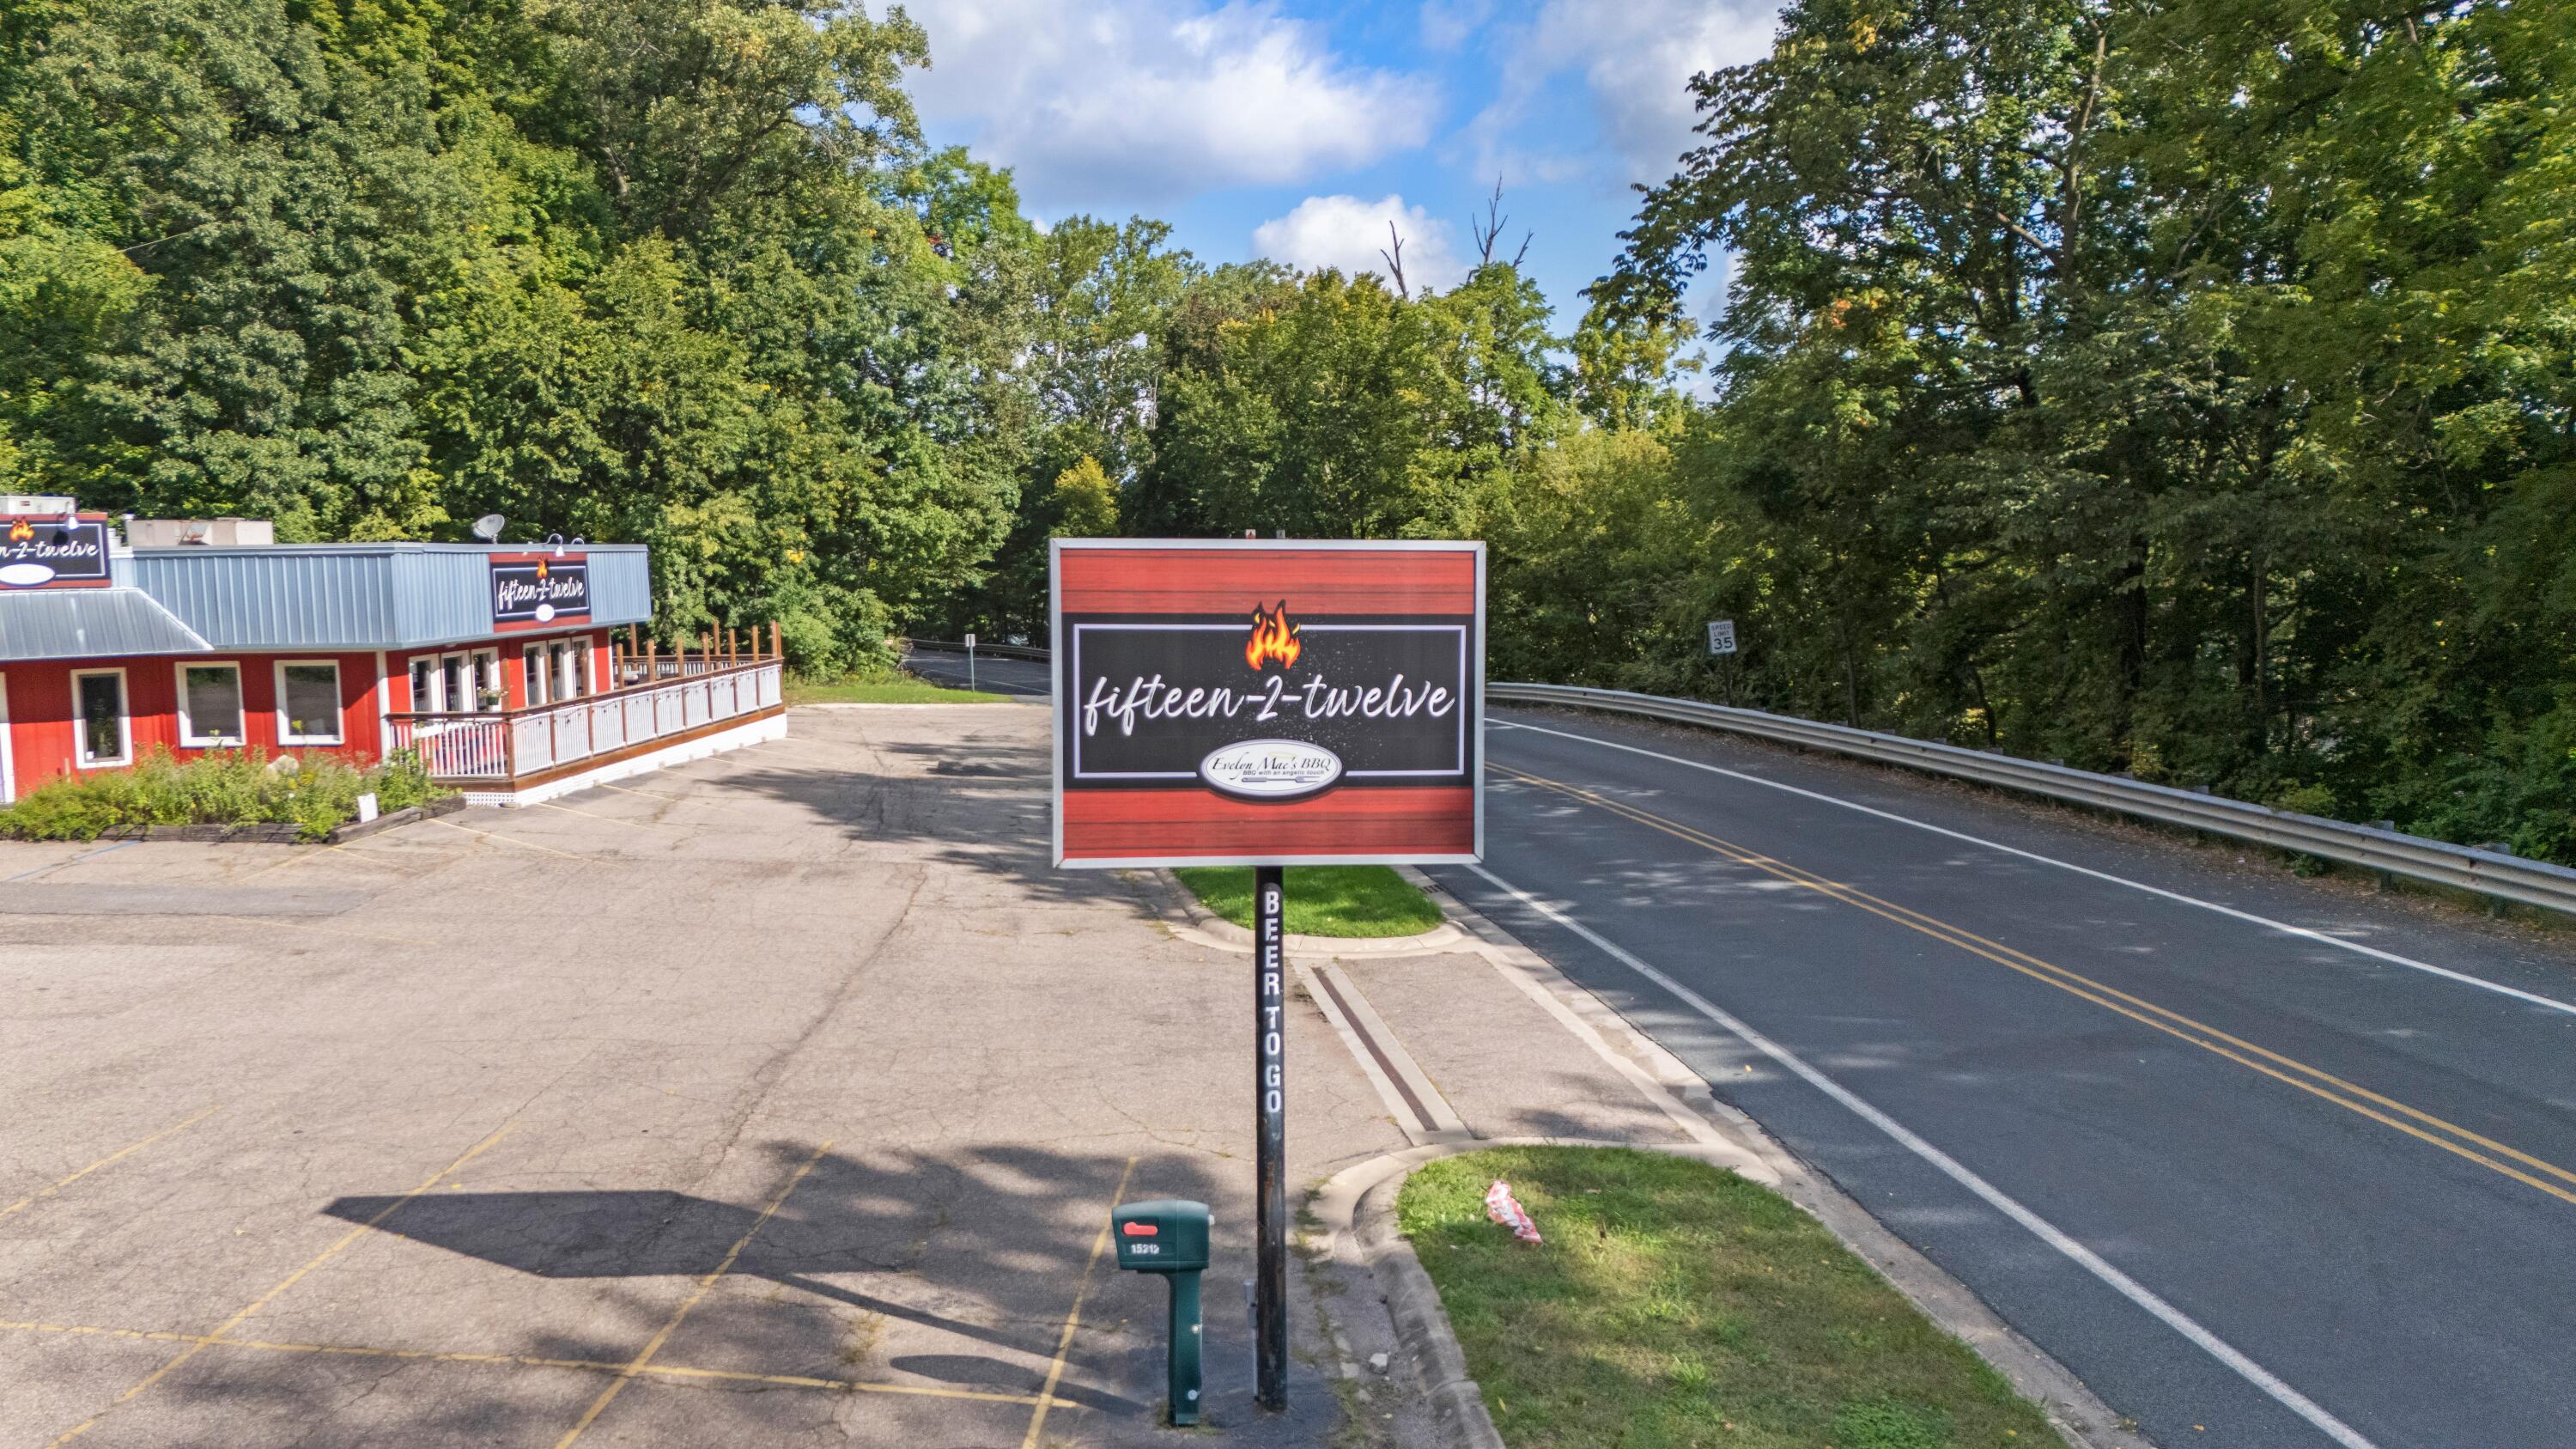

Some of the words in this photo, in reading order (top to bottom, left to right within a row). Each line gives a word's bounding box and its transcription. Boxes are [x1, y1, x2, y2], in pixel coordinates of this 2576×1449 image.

[497, 576, 585, 611] fifteen-2-twelve
[1714, 636, 1733, 649] 35
[1083, 673, 1455, 736] fifteen-2-twelve
[1256, 756, 1297, 770] Mae's
[1301, 758, 1331, 771] BBQ
[1264, 891, 1279, 995] BEER
[1265, 1006, 1280, 1056] TO
[1265, 1064, 1281, 1113] GO
